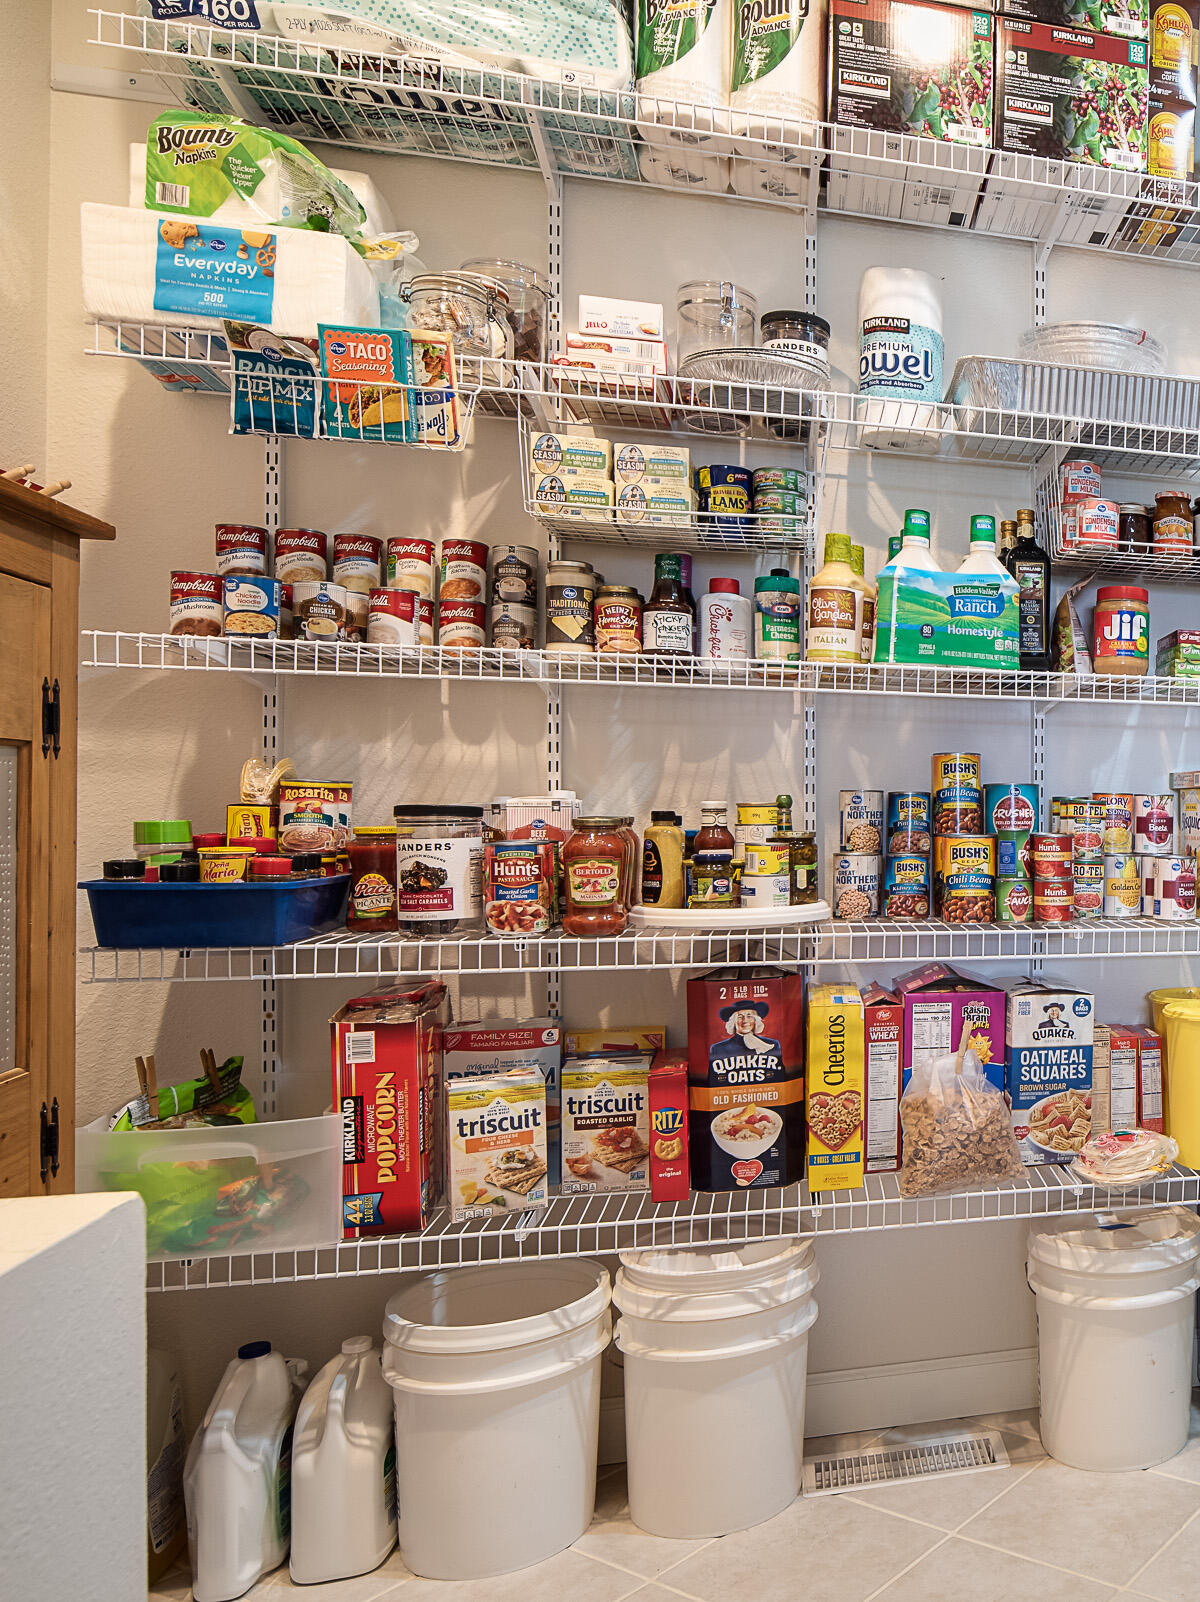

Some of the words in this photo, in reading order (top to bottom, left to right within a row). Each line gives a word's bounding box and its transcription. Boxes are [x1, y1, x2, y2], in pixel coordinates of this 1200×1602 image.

[1053, 30, 1093, 44] KIRKLAND
[1130, 44, 1143, 53] 120
[843, 72, 887, 86] KIRKLAND
[1008, 99, 1050, 112] KIRKLAND
[157, 126, 239, 153] Bounty
[174, 148, 217, 166] Napkins
[228, 156, 242, 165] The
[230, 163, 258, 174] Quicker
[232, 171, 253, 180] Picker
[233, 178, 254, 187] Upper
[174, 253, 258, 279] Everyday
[191, 272, 240, 284] NAPKINS
[204, 292, 224, 303] 500
[864, 318, 908, 329] KIRKLAND
[347, 342, 387, 361] TACO
[863, 342, 912, 353] PREMIUM
[332, 359, 387, 376] Seasoning
[238, 377, 269, 394] DIP
[274, 382, 312, 400] MIX
[533, 450, 563, 461] SEASON
[617, 461, 647, 471] SEASON
[649, 464, 685, 472] SARDINES
[1071, 478, 1099, 486] CONDENSED
[536, 491, 567, 502] SEASON
[568, 496, 606, 504] SARDINES
[618, 499, 648, 510] SEASON
[650, 503, 686, 511] SARDINES
[1084, 517, 1116, 526] CONDENSED
[217, 528, 260, 544] Campbell's
[278, 534, 319, 548] Campbell's
[389, 541, 426, 554] Campbell's
[235, 592, 262, 600] Chicken
[956, 586, 978, 595] Hidden
[978, 585, 999, 596] Valley
[550, 599, 589, 609] TRADITIONAL
[812, 597, 837, 611] Olive
[955, 599, 997, 614] Ranch
[310, 607, 336, 616] CHICKEN
[814, 607, 853, 623] Garden
[652, 614, 683, 627] STICKY
[658, 624, 691, 636] FINGERS
[766, 624, 798, 634] Parmesan
[948, 624, 1003, 640] Homestyle
[1104, 614, 1147, 640] Jif
[771, 631, 794, 641] Cheese
[813, 635, 847, 645] ITALIAN
[943, 764, 977, 775] BUSH'S
[285, 788, 334, 802] Rosarita
[992, 809, 1034, 818] CRUSHED
[531, 829, 547, 837] BEEF
[1149, 824, 1168, 832] Beets
[398, 842, 452, 852] SANDERS
[1039, 843, 1060, 851] Hunt's
[952, 847, 989, 860] BUSH'S
[208, 860, 230, 870] Doña
[494, 861, 540, 877] Hunt's
[897, 863, 925, 872] BUSH'S
[203, 868, 238, 882] Maria
[576, 868, 611, 876] BERTOLLI
[836, 875, 878, 885] NORTHERN
[969, 876, 992, 885] Beans
[354, 882, 392, 897] Pace
[1111, 884, 1134, 892] Golden
[719, 988, 726, 999] 2
[962, 1006, 990, 1015] Raisin
[870, 1032, 898, 1040] WHEAT
[823, 1015, 845, 1086] Cheerios
[1020, 1049, 1086, 1065] OATMEAL
[712, 1055, 780, 1075] QUAKER
[727, 1069, 765, 1084] OATS
[1020, 1064, 1087, 1082] SQUARES
[1019, 1083, 1044, 1092] BROWN
[1044, 1082, 1067, 1091] SUGAR
[566, 1092, 644, 1116] triscuit
[713, 1095, 730, 1105] OLD
[732, 1092, 778, 1103] FASHIONED
[456, 1107, 541, 1138] triscuit
[652, 1110, 684, 1131] RITZ
[343, 1099, 356, 1161] KIRKLAND
[367, 1104, 375, 1153] MICROWAVE
[375, 1072, 398, 1184] POPCORN
[345, 1198, 363, 1225] 44
